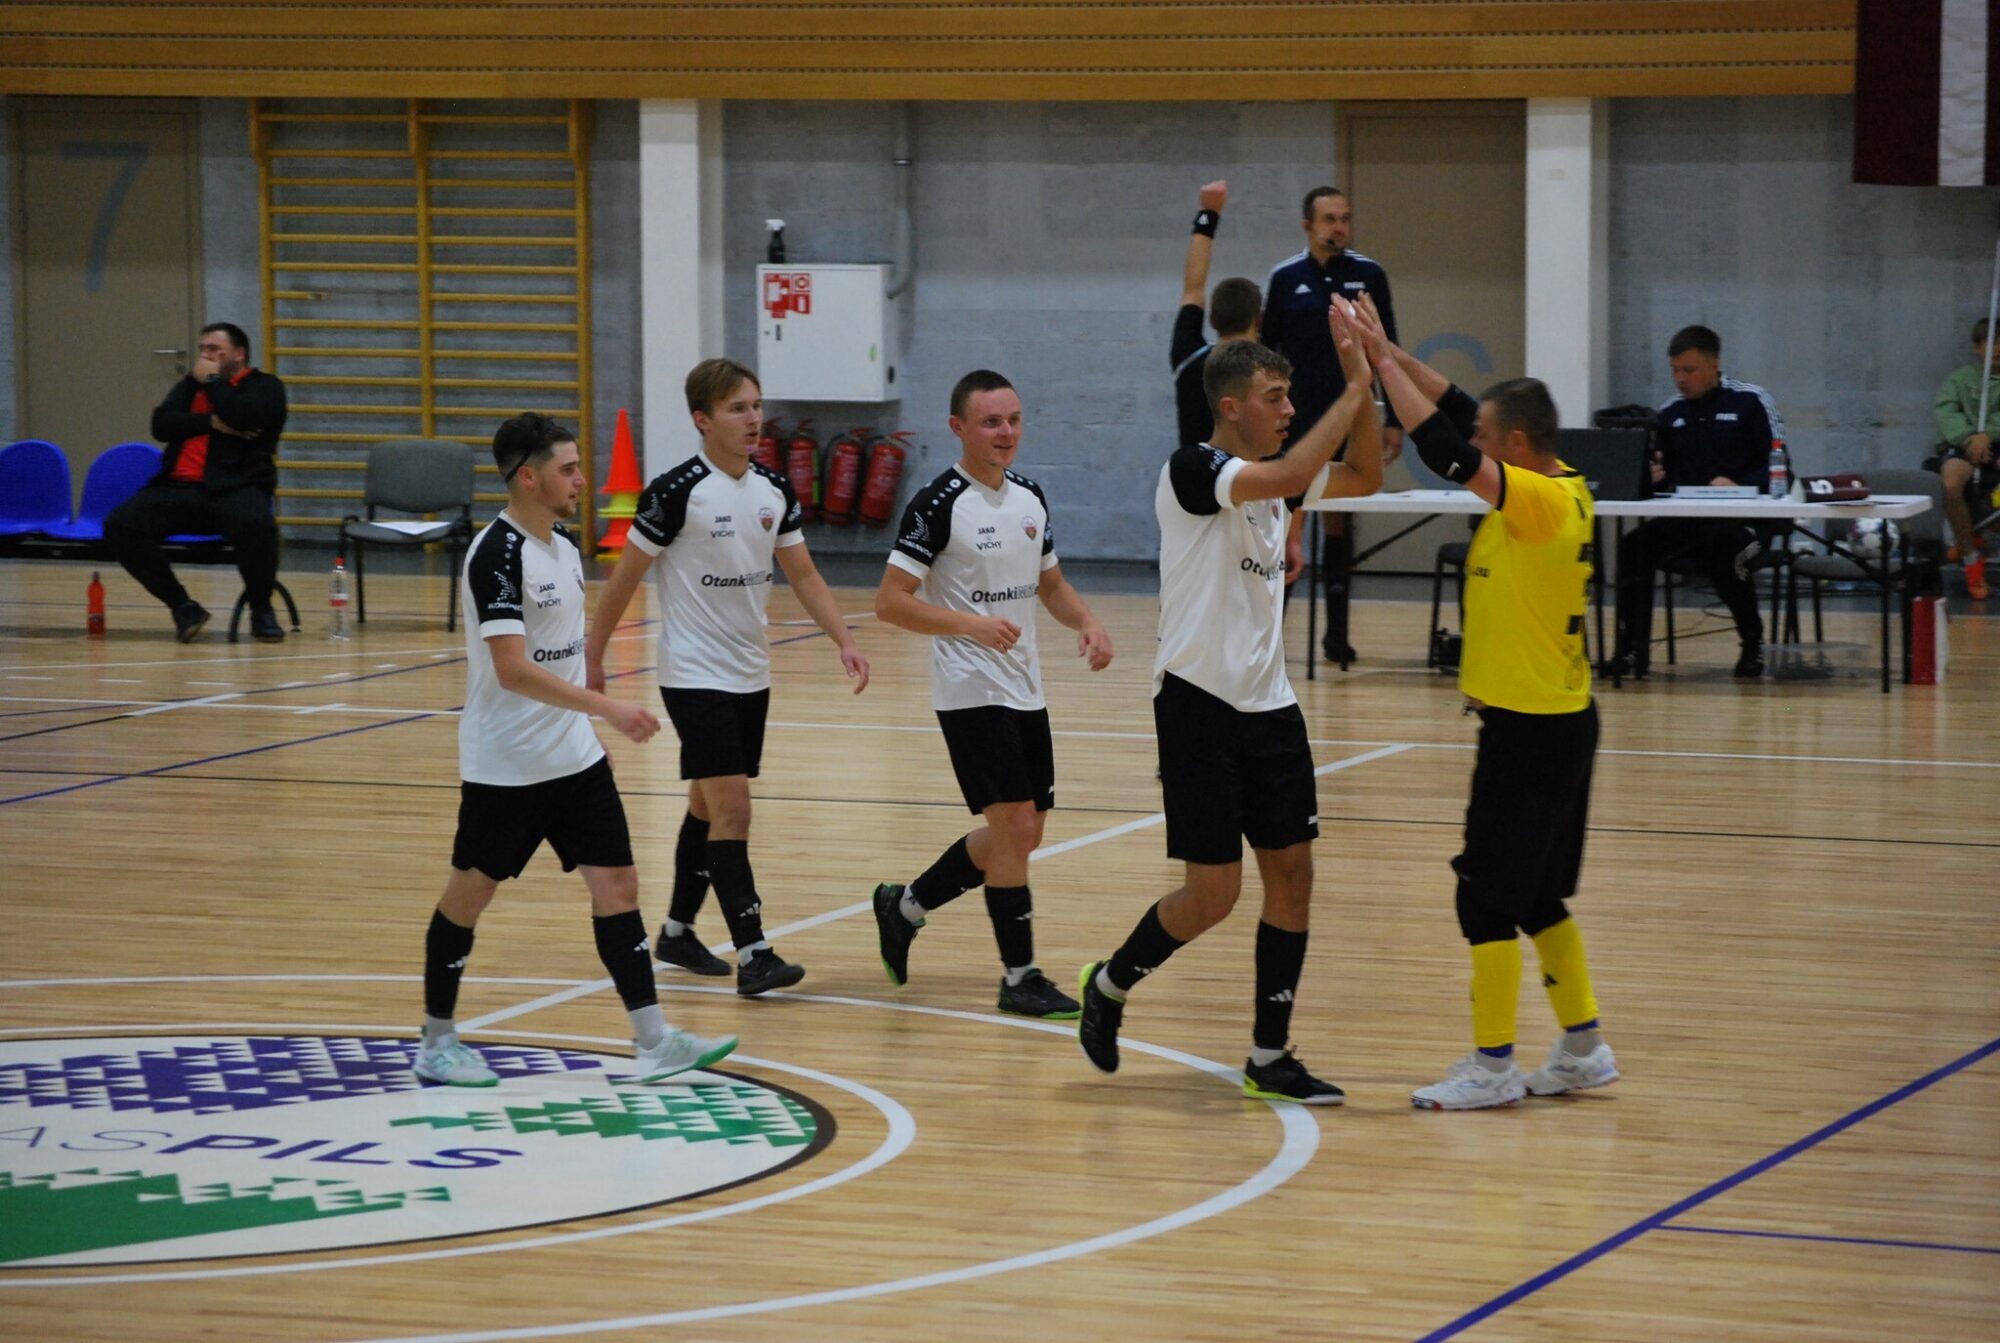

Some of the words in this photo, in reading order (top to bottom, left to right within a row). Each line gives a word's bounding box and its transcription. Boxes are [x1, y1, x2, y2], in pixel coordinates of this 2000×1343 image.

[62, 141, 150, 293] 7
[977, 526, 996, 535] JAKO
[976, 540, 1002, 551] VICHY
[536, 598, 562, 609] VICHY
